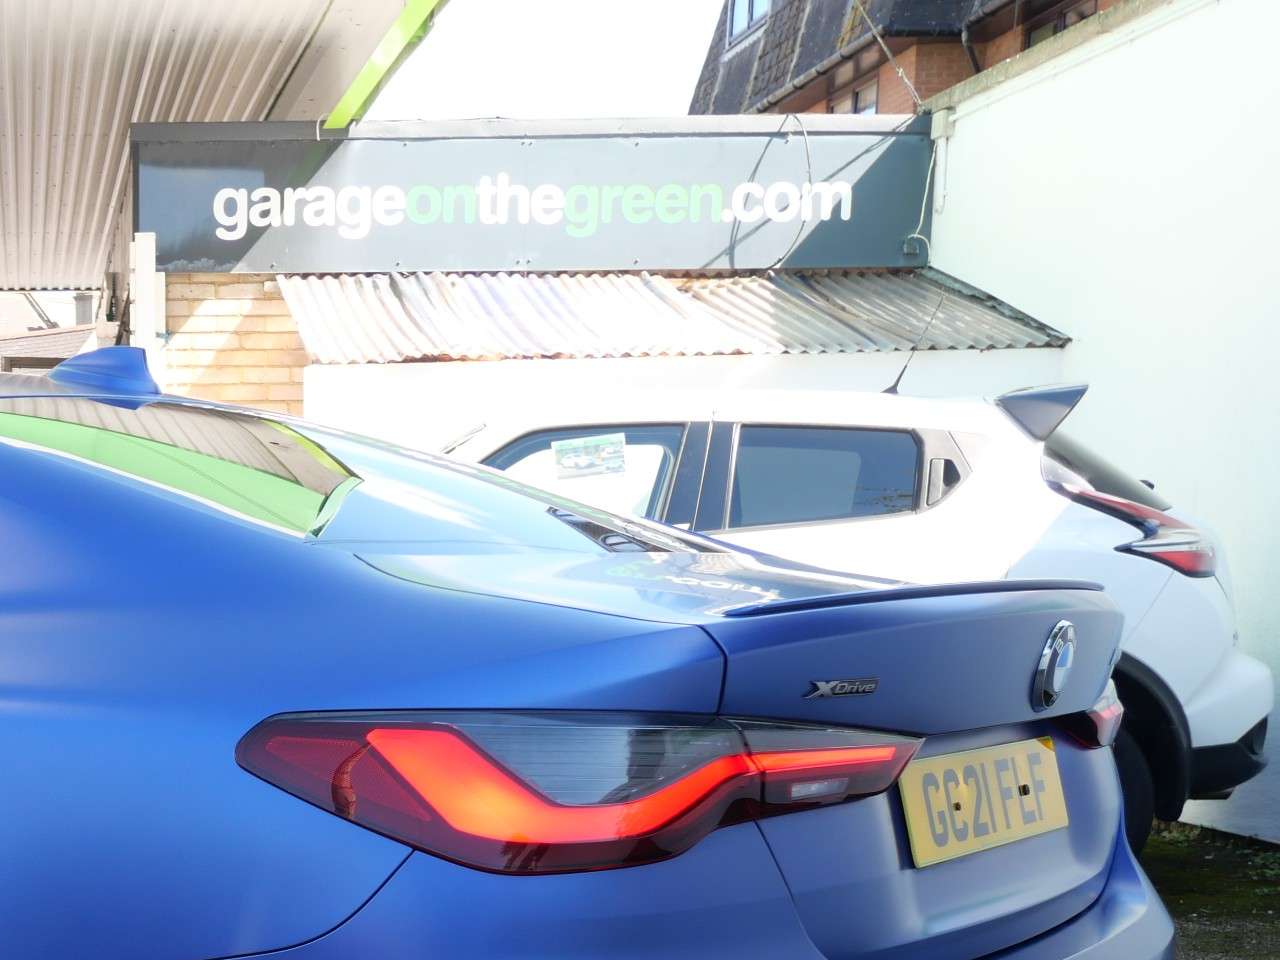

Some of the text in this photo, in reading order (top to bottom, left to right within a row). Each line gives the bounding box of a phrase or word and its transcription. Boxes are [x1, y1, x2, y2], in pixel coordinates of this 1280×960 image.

[213, 172, 852, 240] garageonthegreen.com
[922, 752, 1045, 847] GC21 FLF
